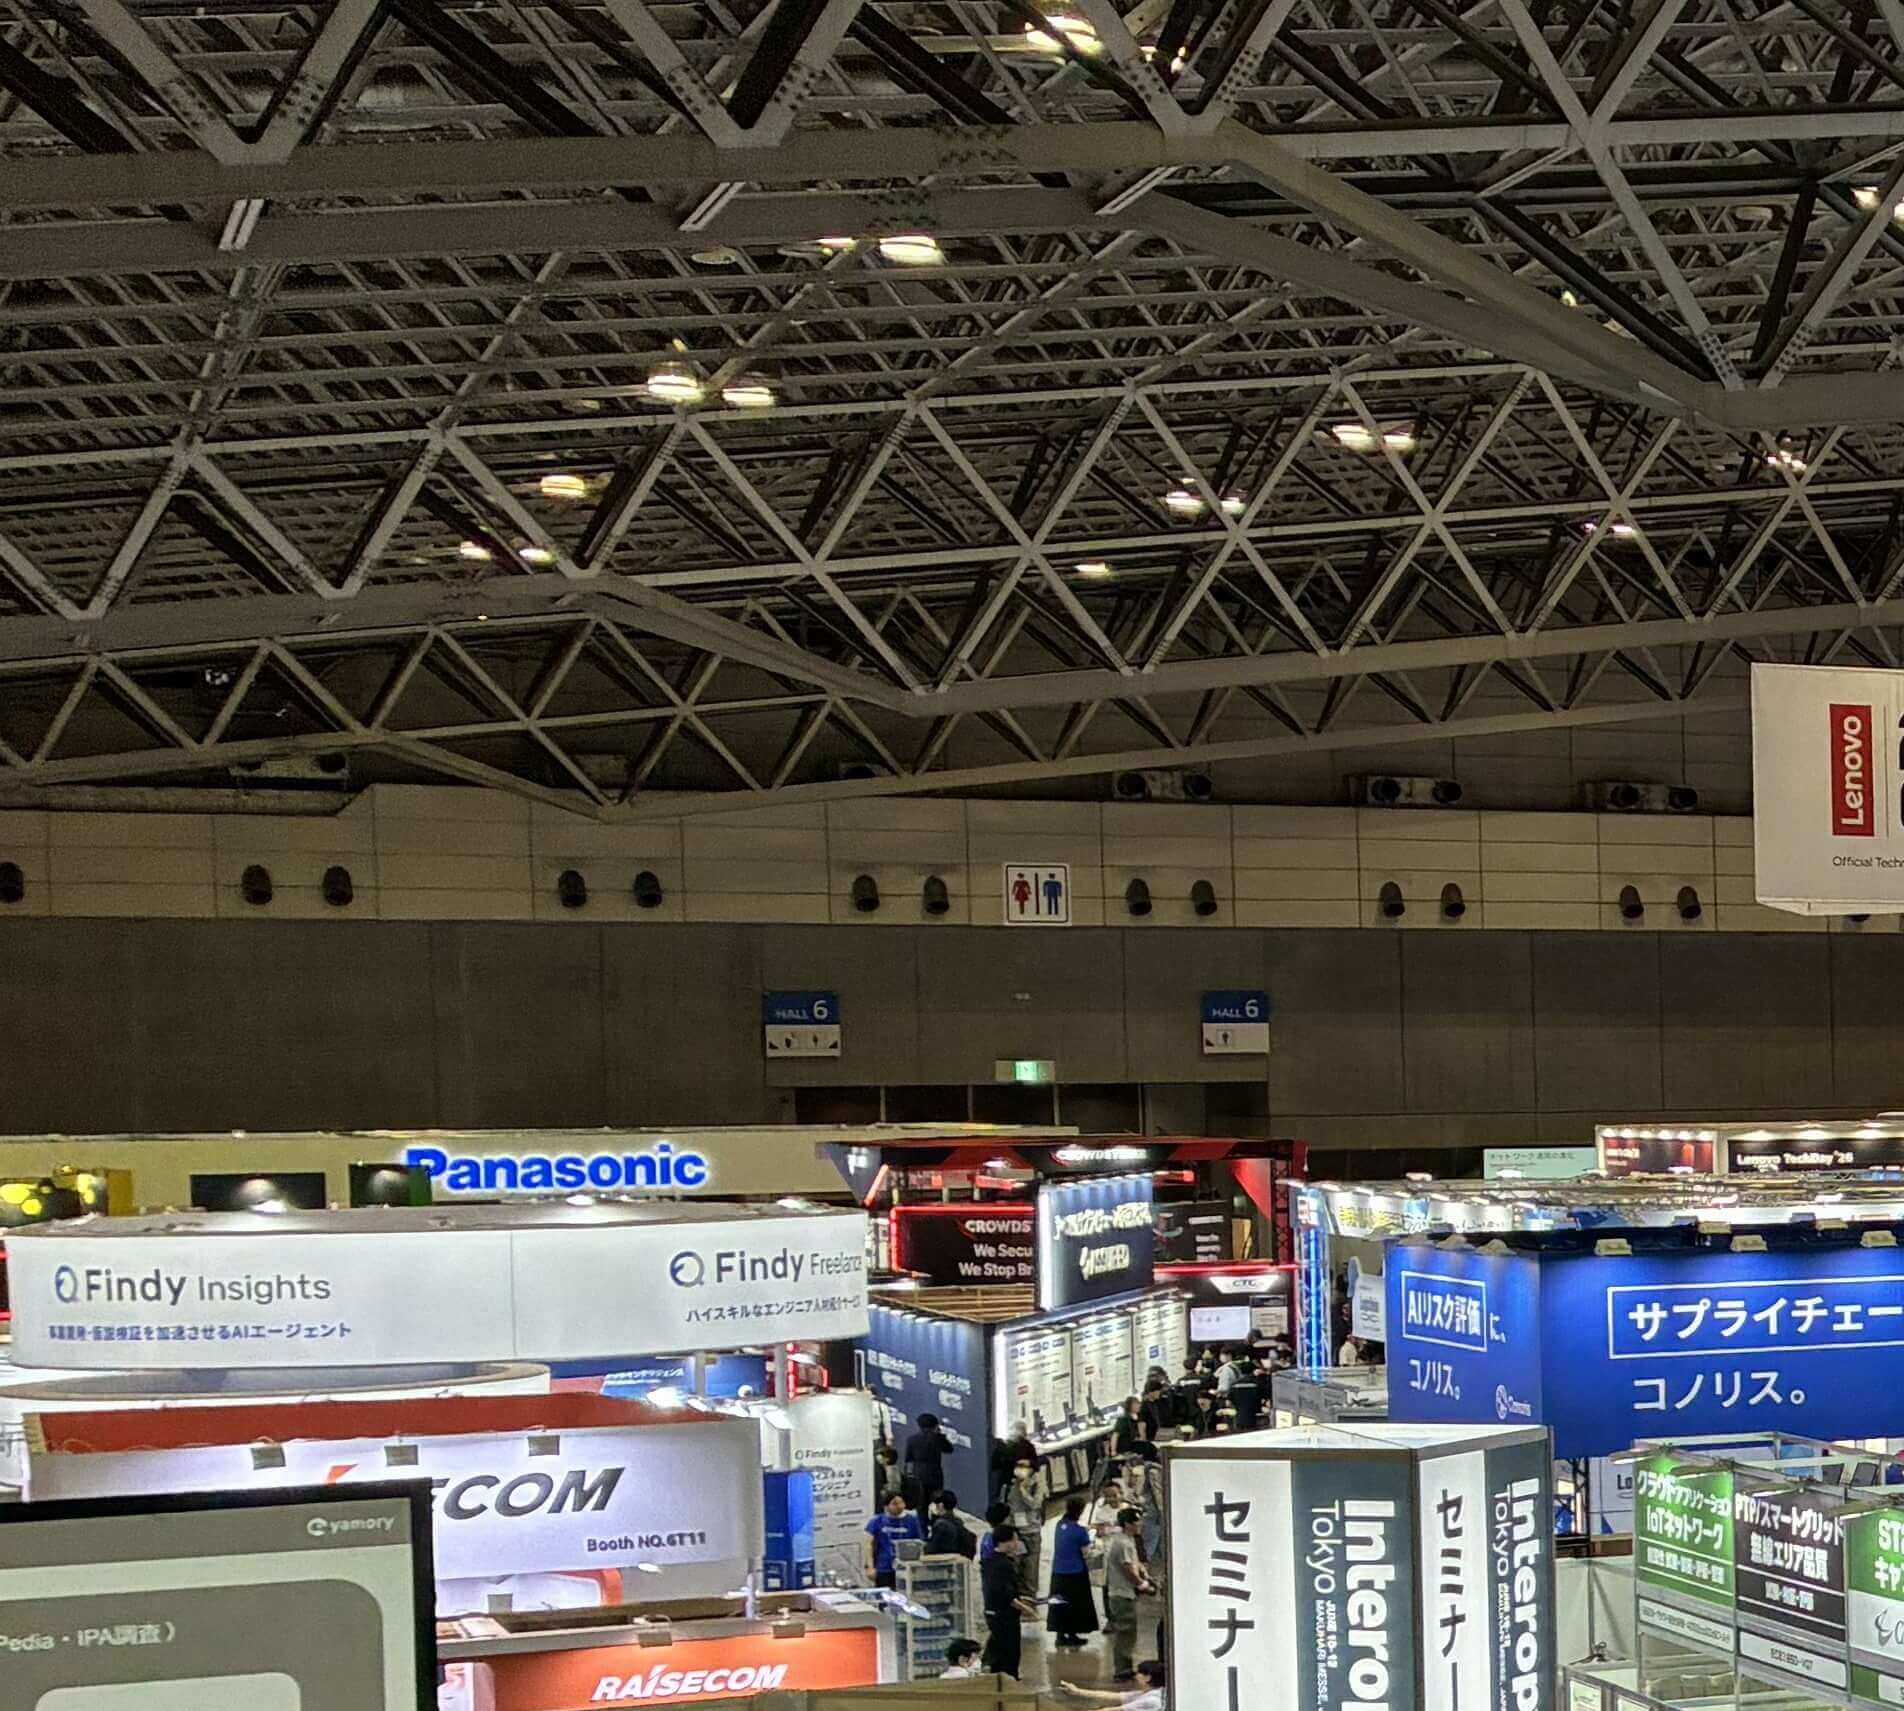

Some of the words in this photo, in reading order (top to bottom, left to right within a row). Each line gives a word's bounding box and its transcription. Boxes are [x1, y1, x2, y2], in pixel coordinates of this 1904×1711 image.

[1841, 715, 1865, 826] Lenovo
[1832, 855, 1873, 870] Official
[812, 999, 828, 1021] 6
[1245, 999, 1259, 1020] 6
[404, 1143, 707, 1191] Panasonic
[714, 1247, 805, 1284] Findy
[973, 1243, 994, 1258] We
[84, 1267, 188, 1306] Findy
[199, 1274, 331, 1304] Insights
[958, 1262, 981, 1277] We
[985, 1262, 1016, 1280] Stop
[1406, 1289, 1482, 1338] AIリスク評価
[1407, 1358, 1462, 1402] コノリス。
[1631, 1369, 1807, 1412] コノリス。
[329, 1514, 395, 1535] yamory
[586, 1535, 635, 1553] Booth
[1493, 1484, 1511, 1577] Tokyo
[1646, 1505, 1724, 1550] IoTネットワーク
[1306, 1500, 1343, 1594] Tokyo
[590, 1663, 788, 1702] RAISECOM
